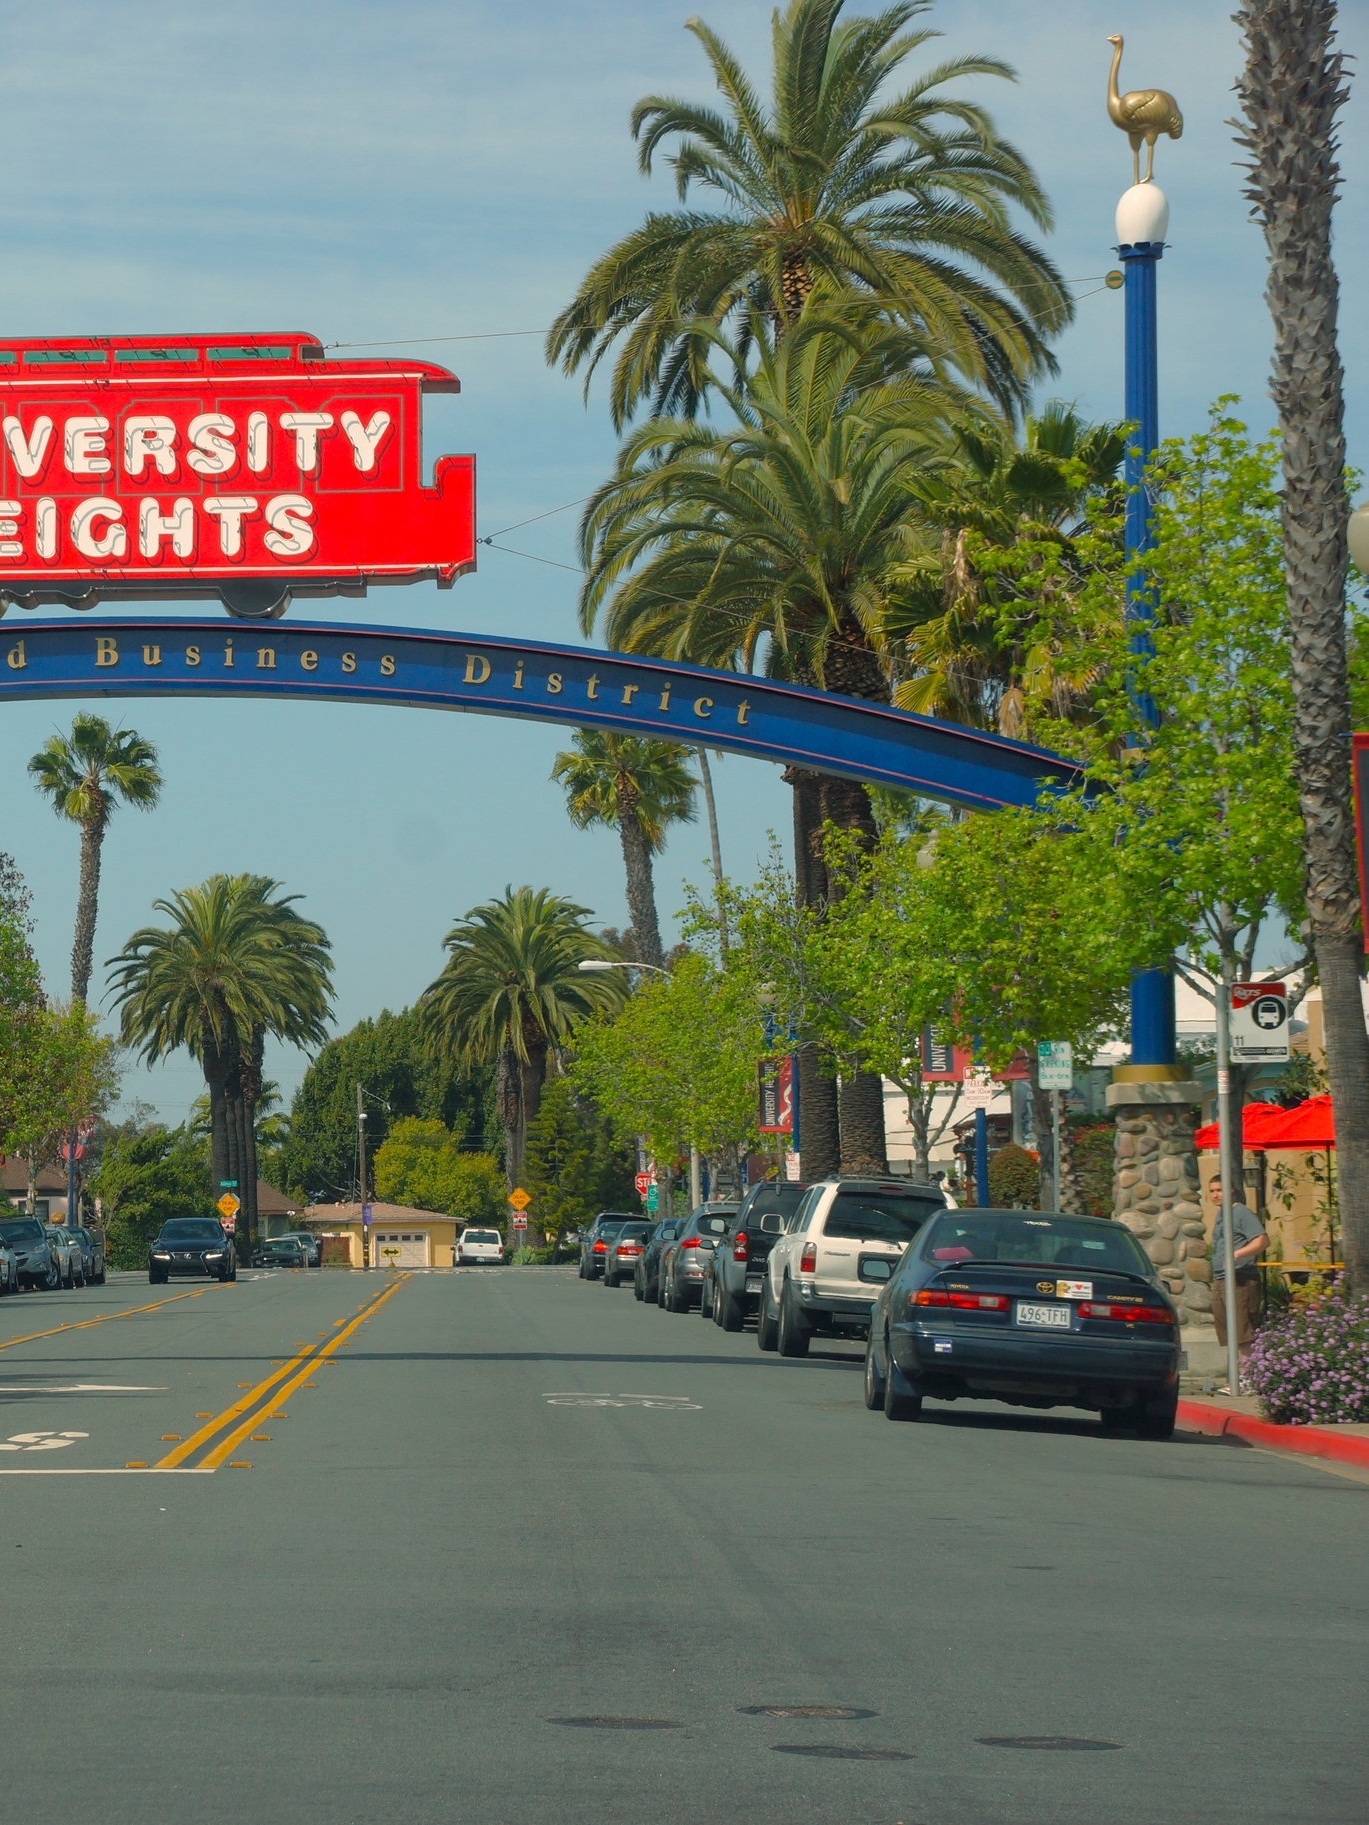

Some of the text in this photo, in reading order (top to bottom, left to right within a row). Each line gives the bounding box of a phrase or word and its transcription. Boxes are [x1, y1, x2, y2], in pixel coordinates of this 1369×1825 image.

[94, 637, 396, 675] Business
[462, 654, 751, 725] District
[1234, 1035, 1244, 1046] 11
[764, 1090, 775, 1126] UNIVERSITY
